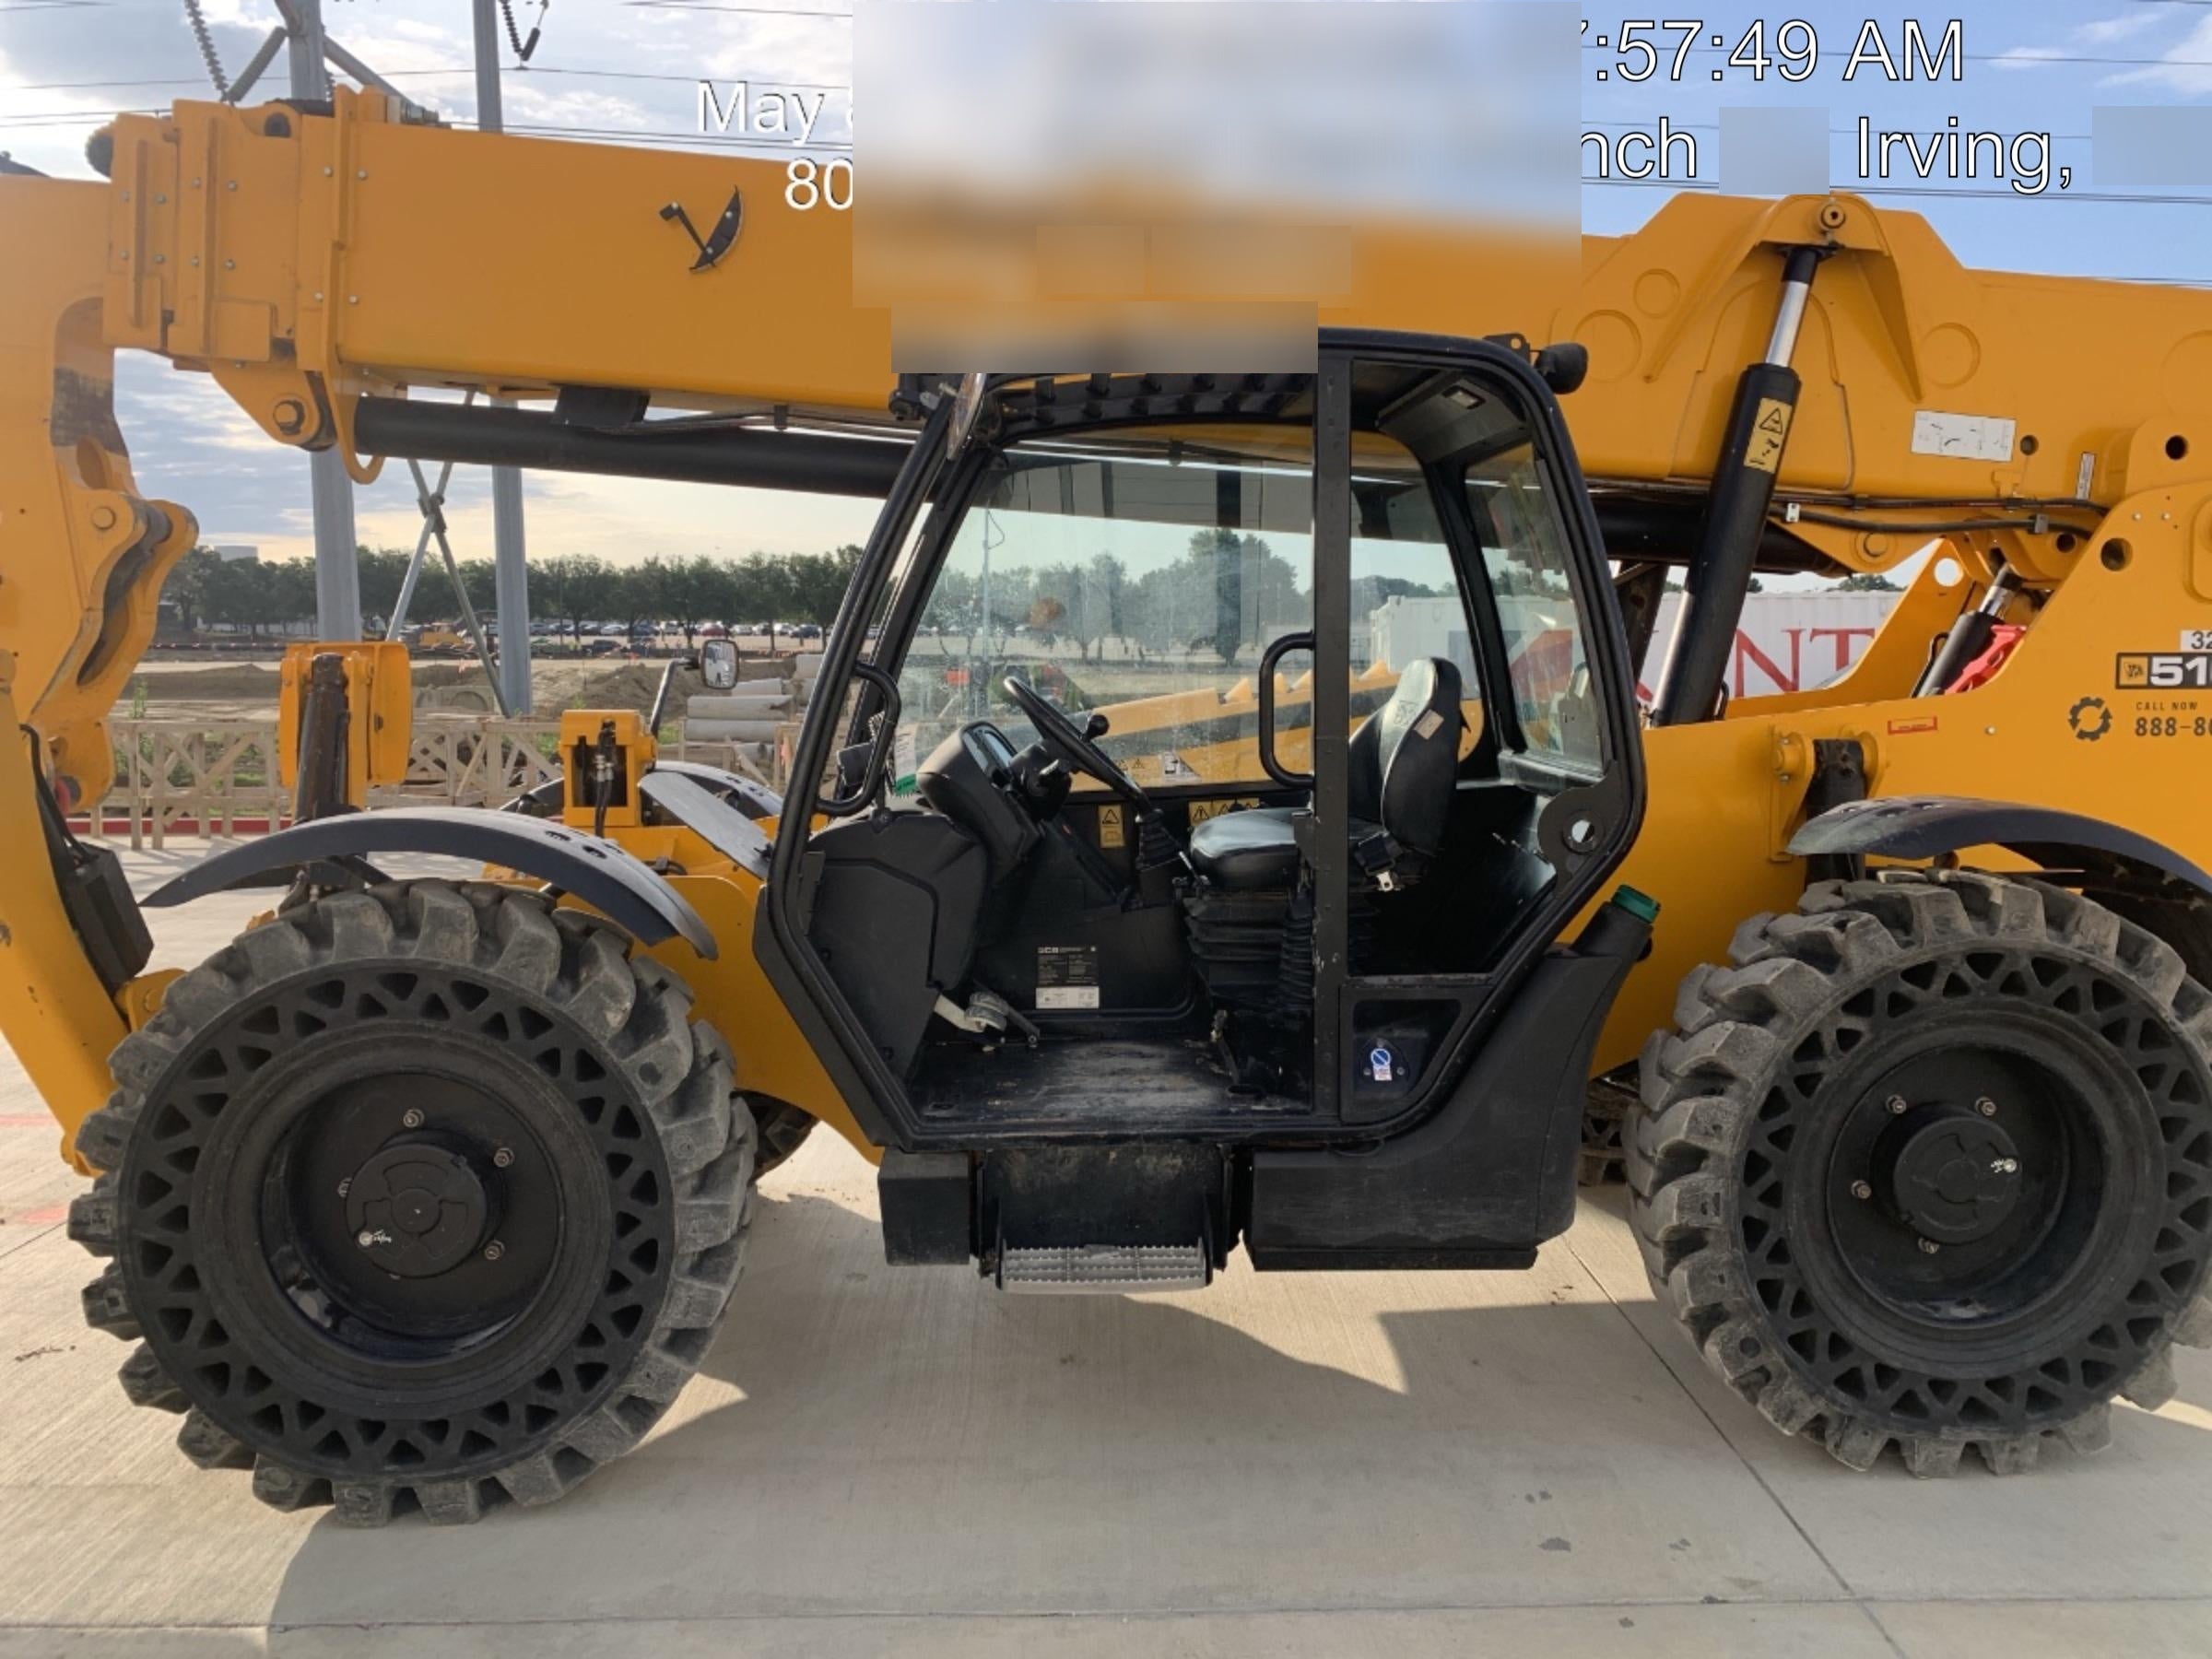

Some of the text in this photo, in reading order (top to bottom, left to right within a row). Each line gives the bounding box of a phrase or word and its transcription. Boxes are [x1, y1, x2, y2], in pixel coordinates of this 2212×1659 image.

[2149, 655, 2212, 686] 51
[2136, 701, 2198, 711] CALL NOW
